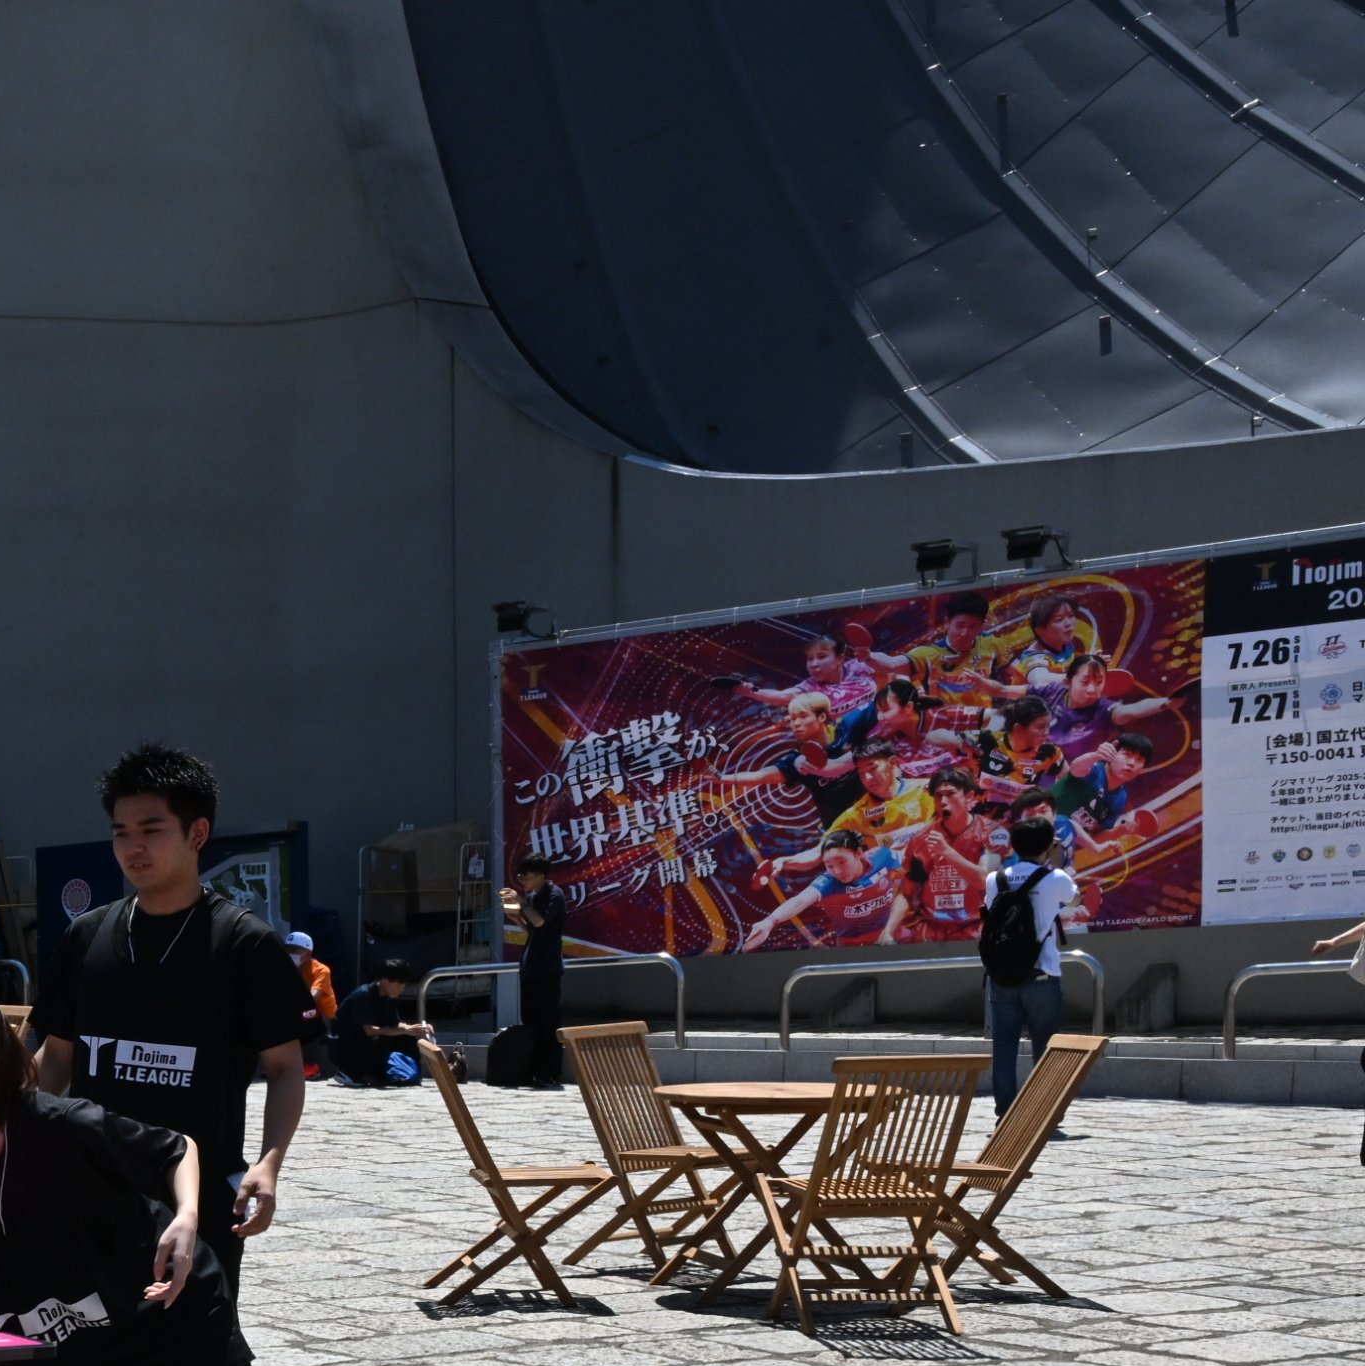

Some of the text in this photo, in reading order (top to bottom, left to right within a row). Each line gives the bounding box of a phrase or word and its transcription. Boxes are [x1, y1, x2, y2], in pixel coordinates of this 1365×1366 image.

[1327, 587, 1365, 610] 20
[1228, 638, 1290, 670] 7.26
[1259, 678, 1296, 688] Presents
[1229, 692, 1287, 724] 7.27
[514, 710, 731, 807] この衝撃が、
[527, 789, 718, 865] 世界基準。
[114, 1064, 192, 1087] T.LEAGUE
